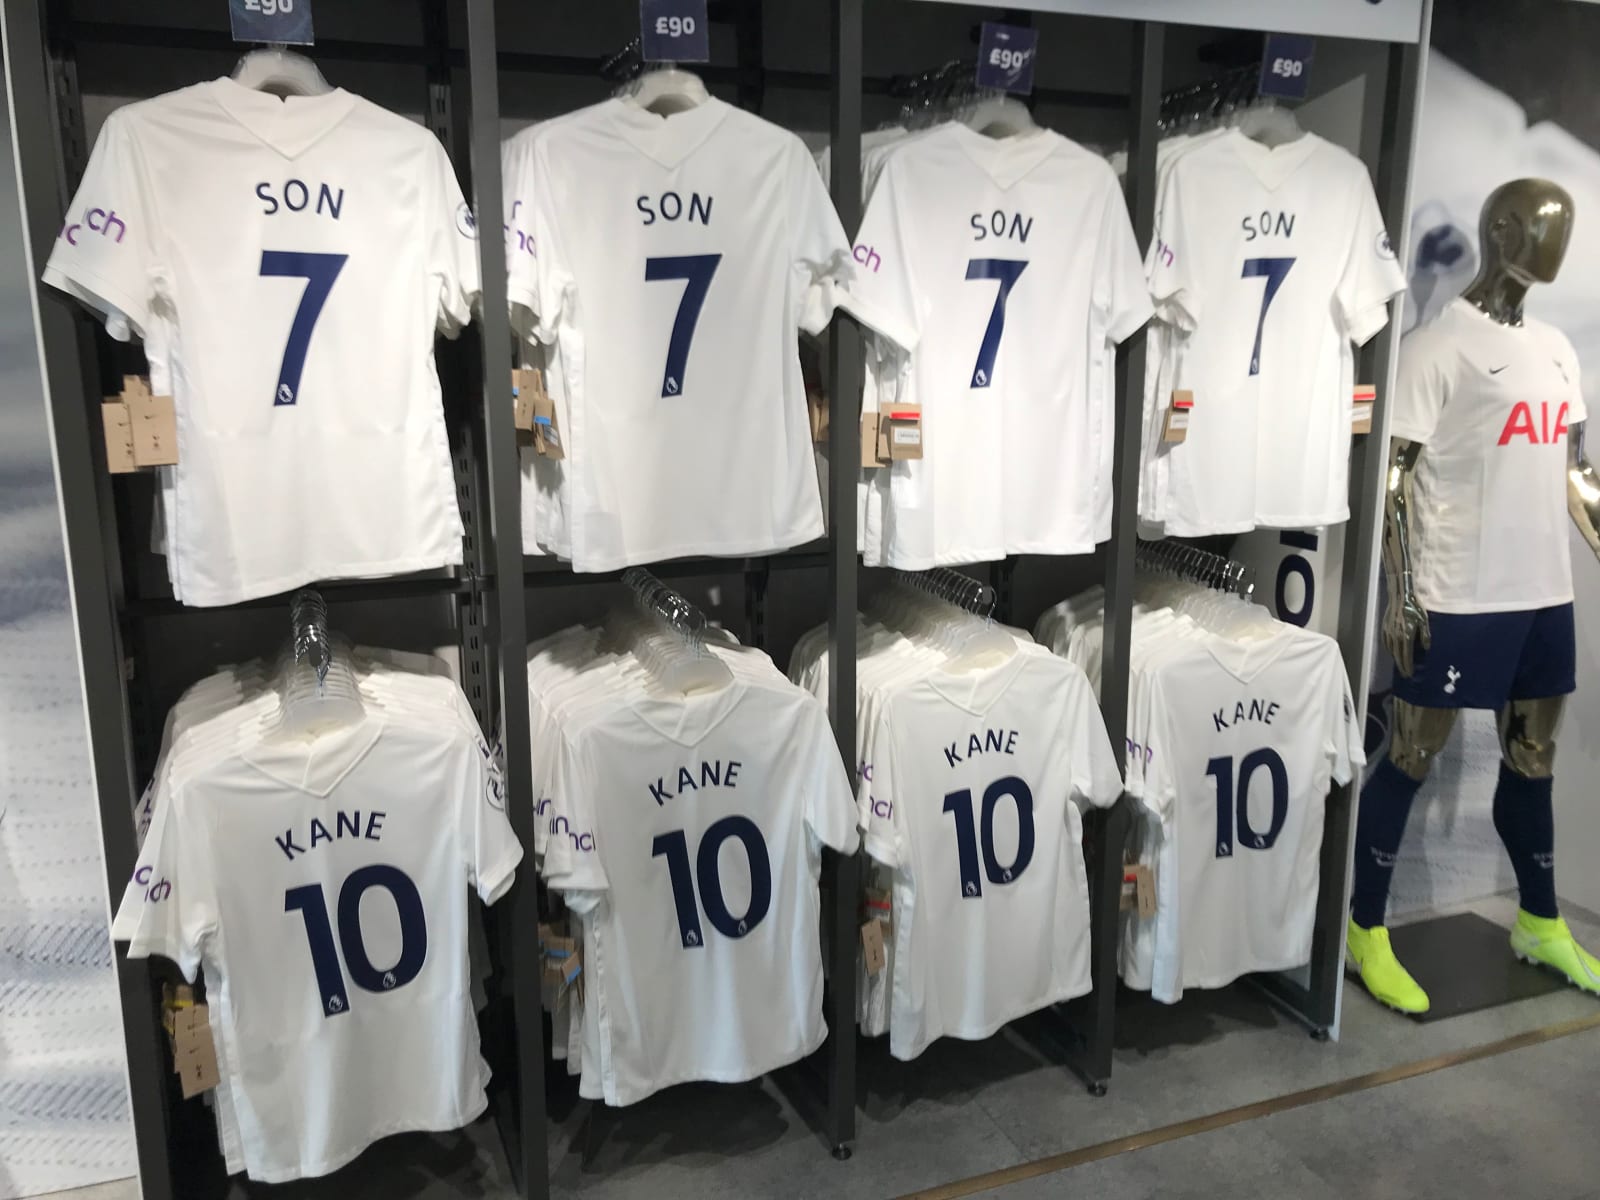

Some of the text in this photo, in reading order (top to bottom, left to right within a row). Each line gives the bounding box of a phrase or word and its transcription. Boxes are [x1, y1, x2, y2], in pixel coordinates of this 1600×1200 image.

[656, 17, 695, 37] £90
[990, 48, 1024, 69] £90
[1273, 58, 1303, 77] £90
[256, 179, 345, 219] SON
[636, 191, 713, 226] SON
[970, 210, 1033, 243] SON
[1242, 211, 1295, 241] SON
[260, 250, 348, 407] 7
[645, 253, 722, 398] 7
[965, 258, 1029, 389] 7
[1242, 257, 1296, 376] 7
[1212, 699, 1280, 733] KANE
[944, 729, 1019, 768] KANE
[648, 759, 742, 807] KANE
[1205, 747, 1289, 859] 10
[274, 810, 387, 861] KANE
[942, 776, 1035, 899] 10
[652, 815, 772, 949] 10
[285, 864, 428, 1018] 10
